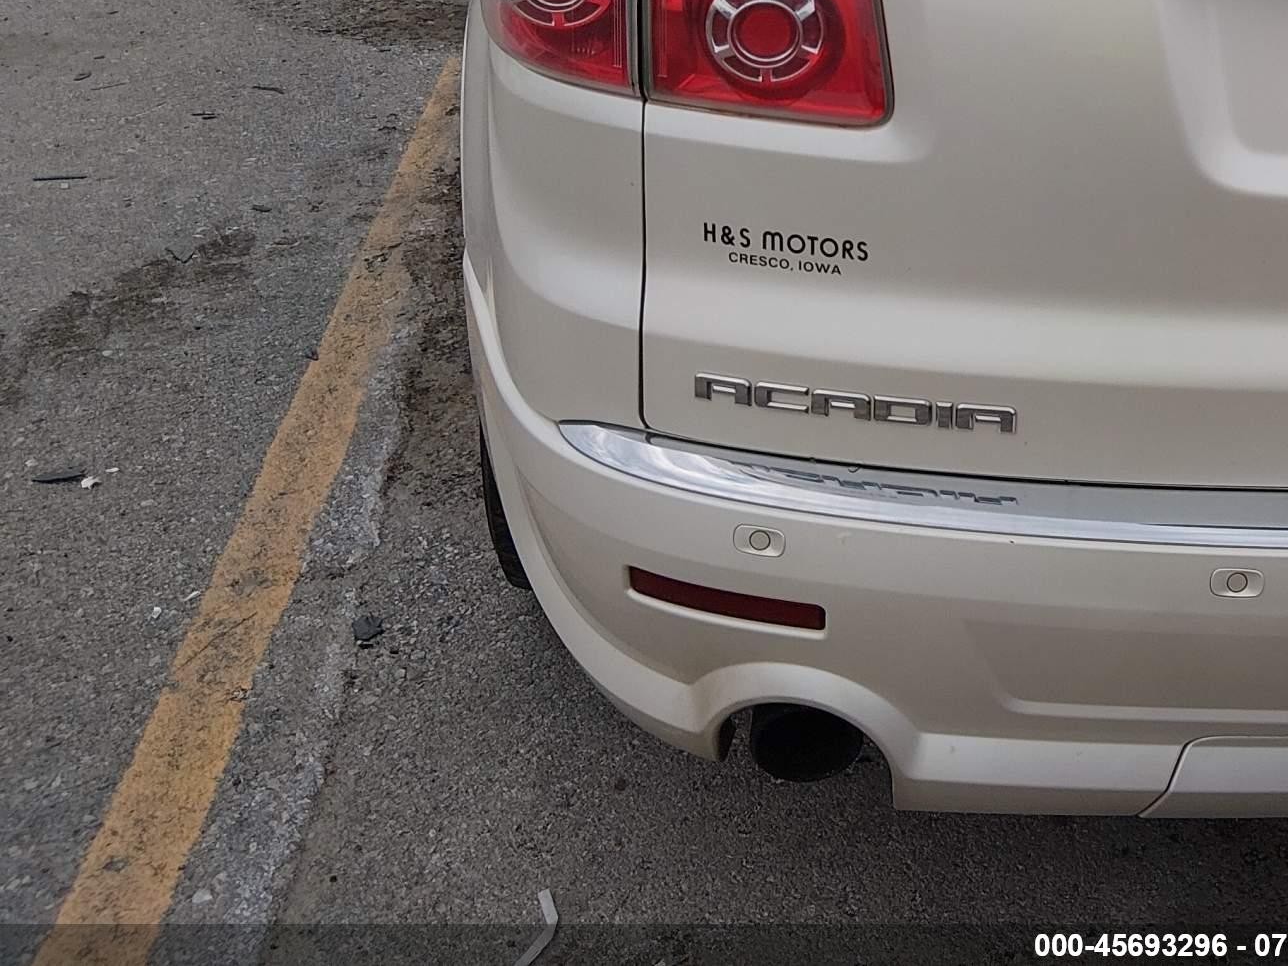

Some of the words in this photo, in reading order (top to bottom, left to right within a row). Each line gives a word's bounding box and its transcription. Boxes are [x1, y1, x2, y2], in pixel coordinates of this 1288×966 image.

[703, 221, 751, 248] H&S
[762, 230, 869, 262] MOTORS
[728, 251, 794, 272] CRESCO,
[798, 260, 842, 276] IOWA
[694, 371, 1017, 434] ACADIA
